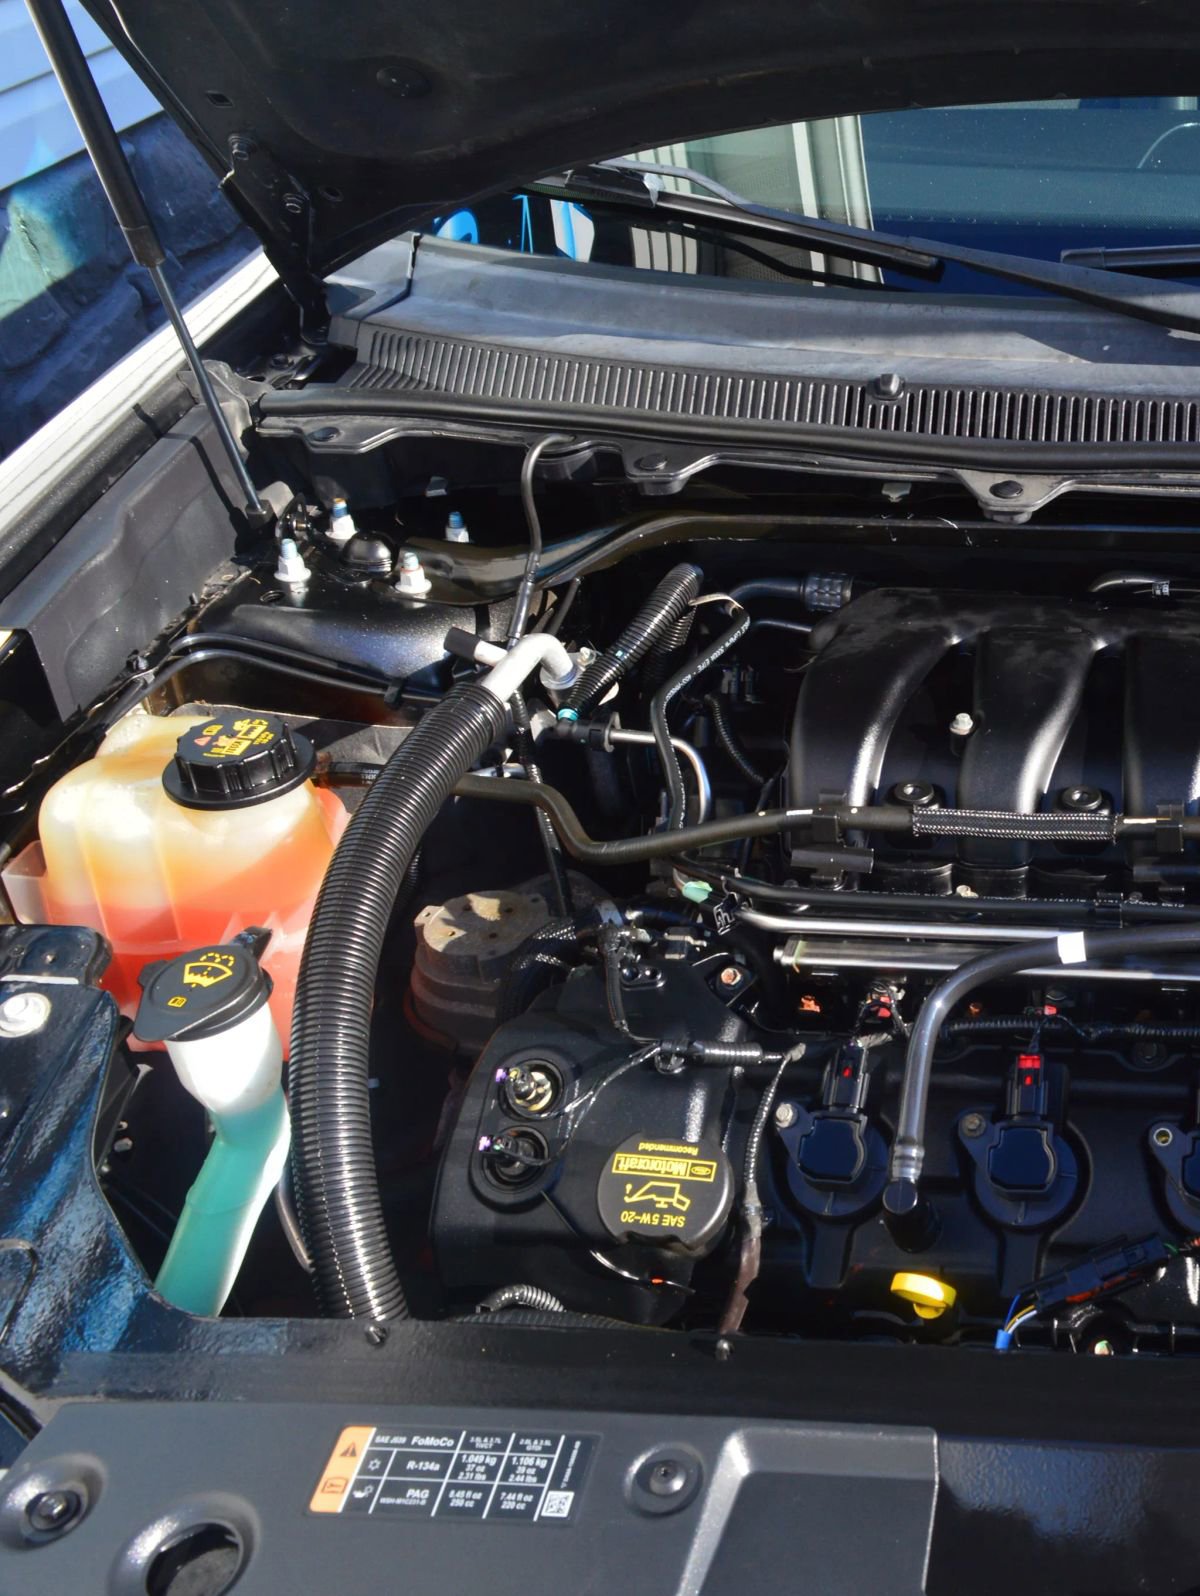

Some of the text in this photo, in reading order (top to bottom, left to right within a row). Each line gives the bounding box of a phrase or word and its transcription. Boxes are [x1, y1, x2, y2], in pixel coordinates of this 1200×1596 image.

[638, 1142, 699, 1156] Recommended
[620, 1210, 686, 1228] SAE 5W-20
[410, 1435, 454, 1447] FoMoCo
[406, 1460, 440, 1470] R-134a
[461, 1453, 497, 1466] 1.049 kg
[535, 1457, 548, 1468] kg
[475, 1464, 486, 1472] oz
[405, 1488, 429, 1498] PAG
